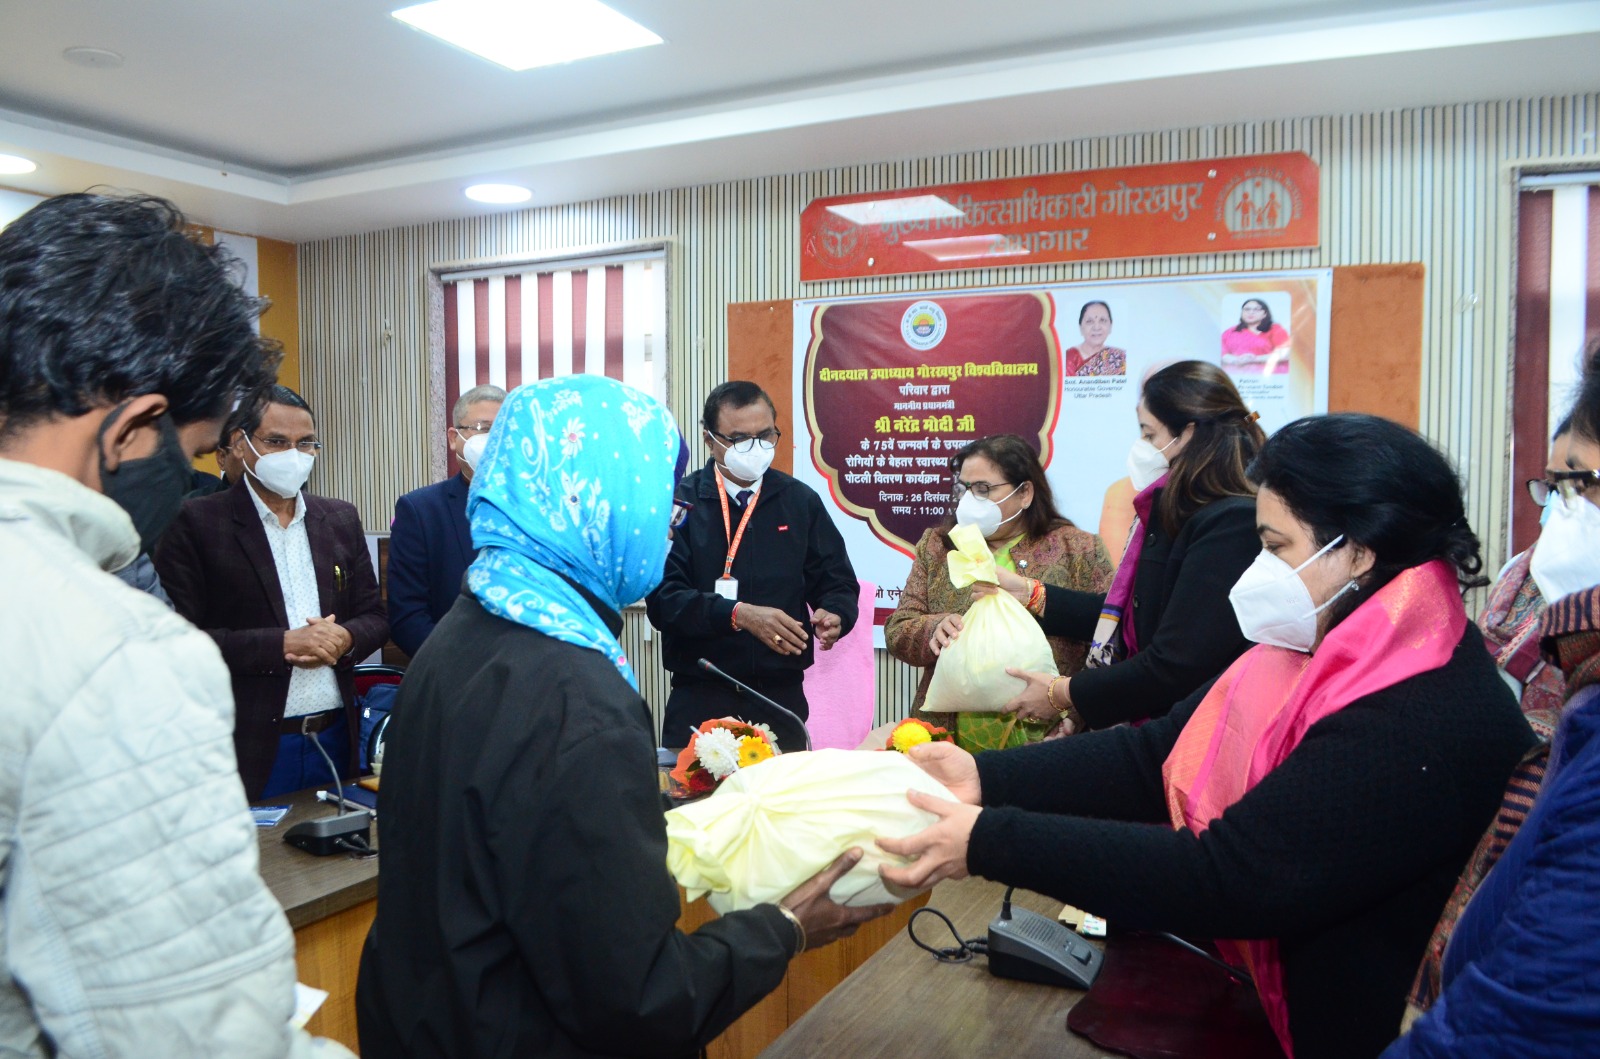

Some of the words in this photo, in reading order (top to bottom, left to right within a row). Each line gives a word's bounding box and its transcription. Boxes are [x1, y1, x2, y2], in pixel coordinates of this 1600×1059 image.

[1101, 180, 1204, 222] गोरखपुर
[819, 367, 868, 382] दीनदयाल
[870, 366, 914, 380] उपाध्याय
[916, 363, 962, 381] गोरखपुर
[964, 361, 1038, 377] विश्वविद्यालय
[899, 382, 928, 396] परिवार
[930, 384, 950, 396] द्वारा
[893, 401, 922, 410] माननीय
[922, 399, 956, 410] प्रधानमंत्री
[874, 416, 891, 433] श्री
[893, 415, 920, 433] नरेंद्र
[923, 415, 954, 432] मोदी
[956, 414, 976, 432] जी
[860, 437, 870, 451] के
[896, 436, 929, 450] जन्मवर्ष
[930, 436, 942, 450] के
[845, 454, 875, 468] रोगियों
[875, 453, 886, 467] के
[888, 454, 913, 468] बेहतर
[915, 456, 949, 468] स्वास्थ्य
[844, 470, 872, 484] पोटली
[873, 470, 903, 483] वितरण
[904, 471, 941, 484] कार्यक्रम
[910, 493, 922, 502] 26
[891, 505, 912, 515] समय
[919, 506, 945, 515] 11:00
